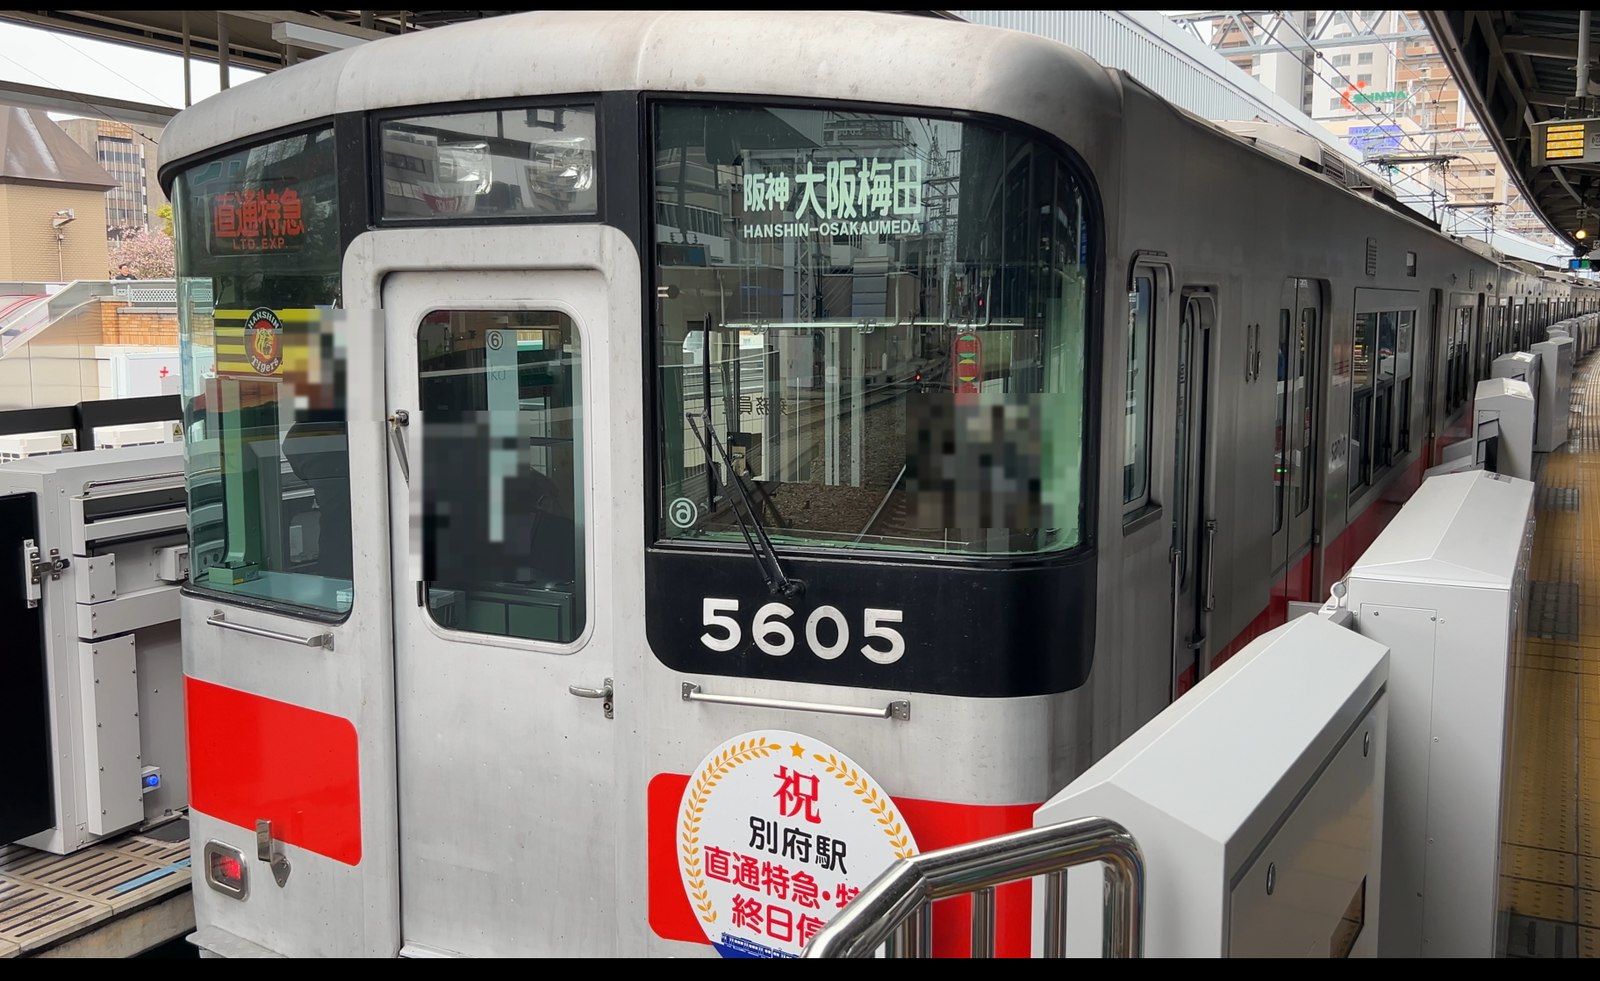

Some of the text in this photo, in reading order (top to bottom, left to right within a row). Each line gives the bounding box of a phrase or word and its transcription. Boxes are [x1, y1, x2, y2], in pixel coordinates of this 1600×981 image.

[214, 187, 305, 238] 直通特急
[743, 157, 922, 220] 阪神 大阪梅田
[743, 219, 921, 239] HANSHIN-OSAKAUMEDA
[247, 310, 280, 330] HANSHIN
[251, 355, 279, 374] Tigers
[700, 597, 906, 664] 5605
[772, 764, 822, 824] 祝
[749, 815, 848, 875] 別府駅
